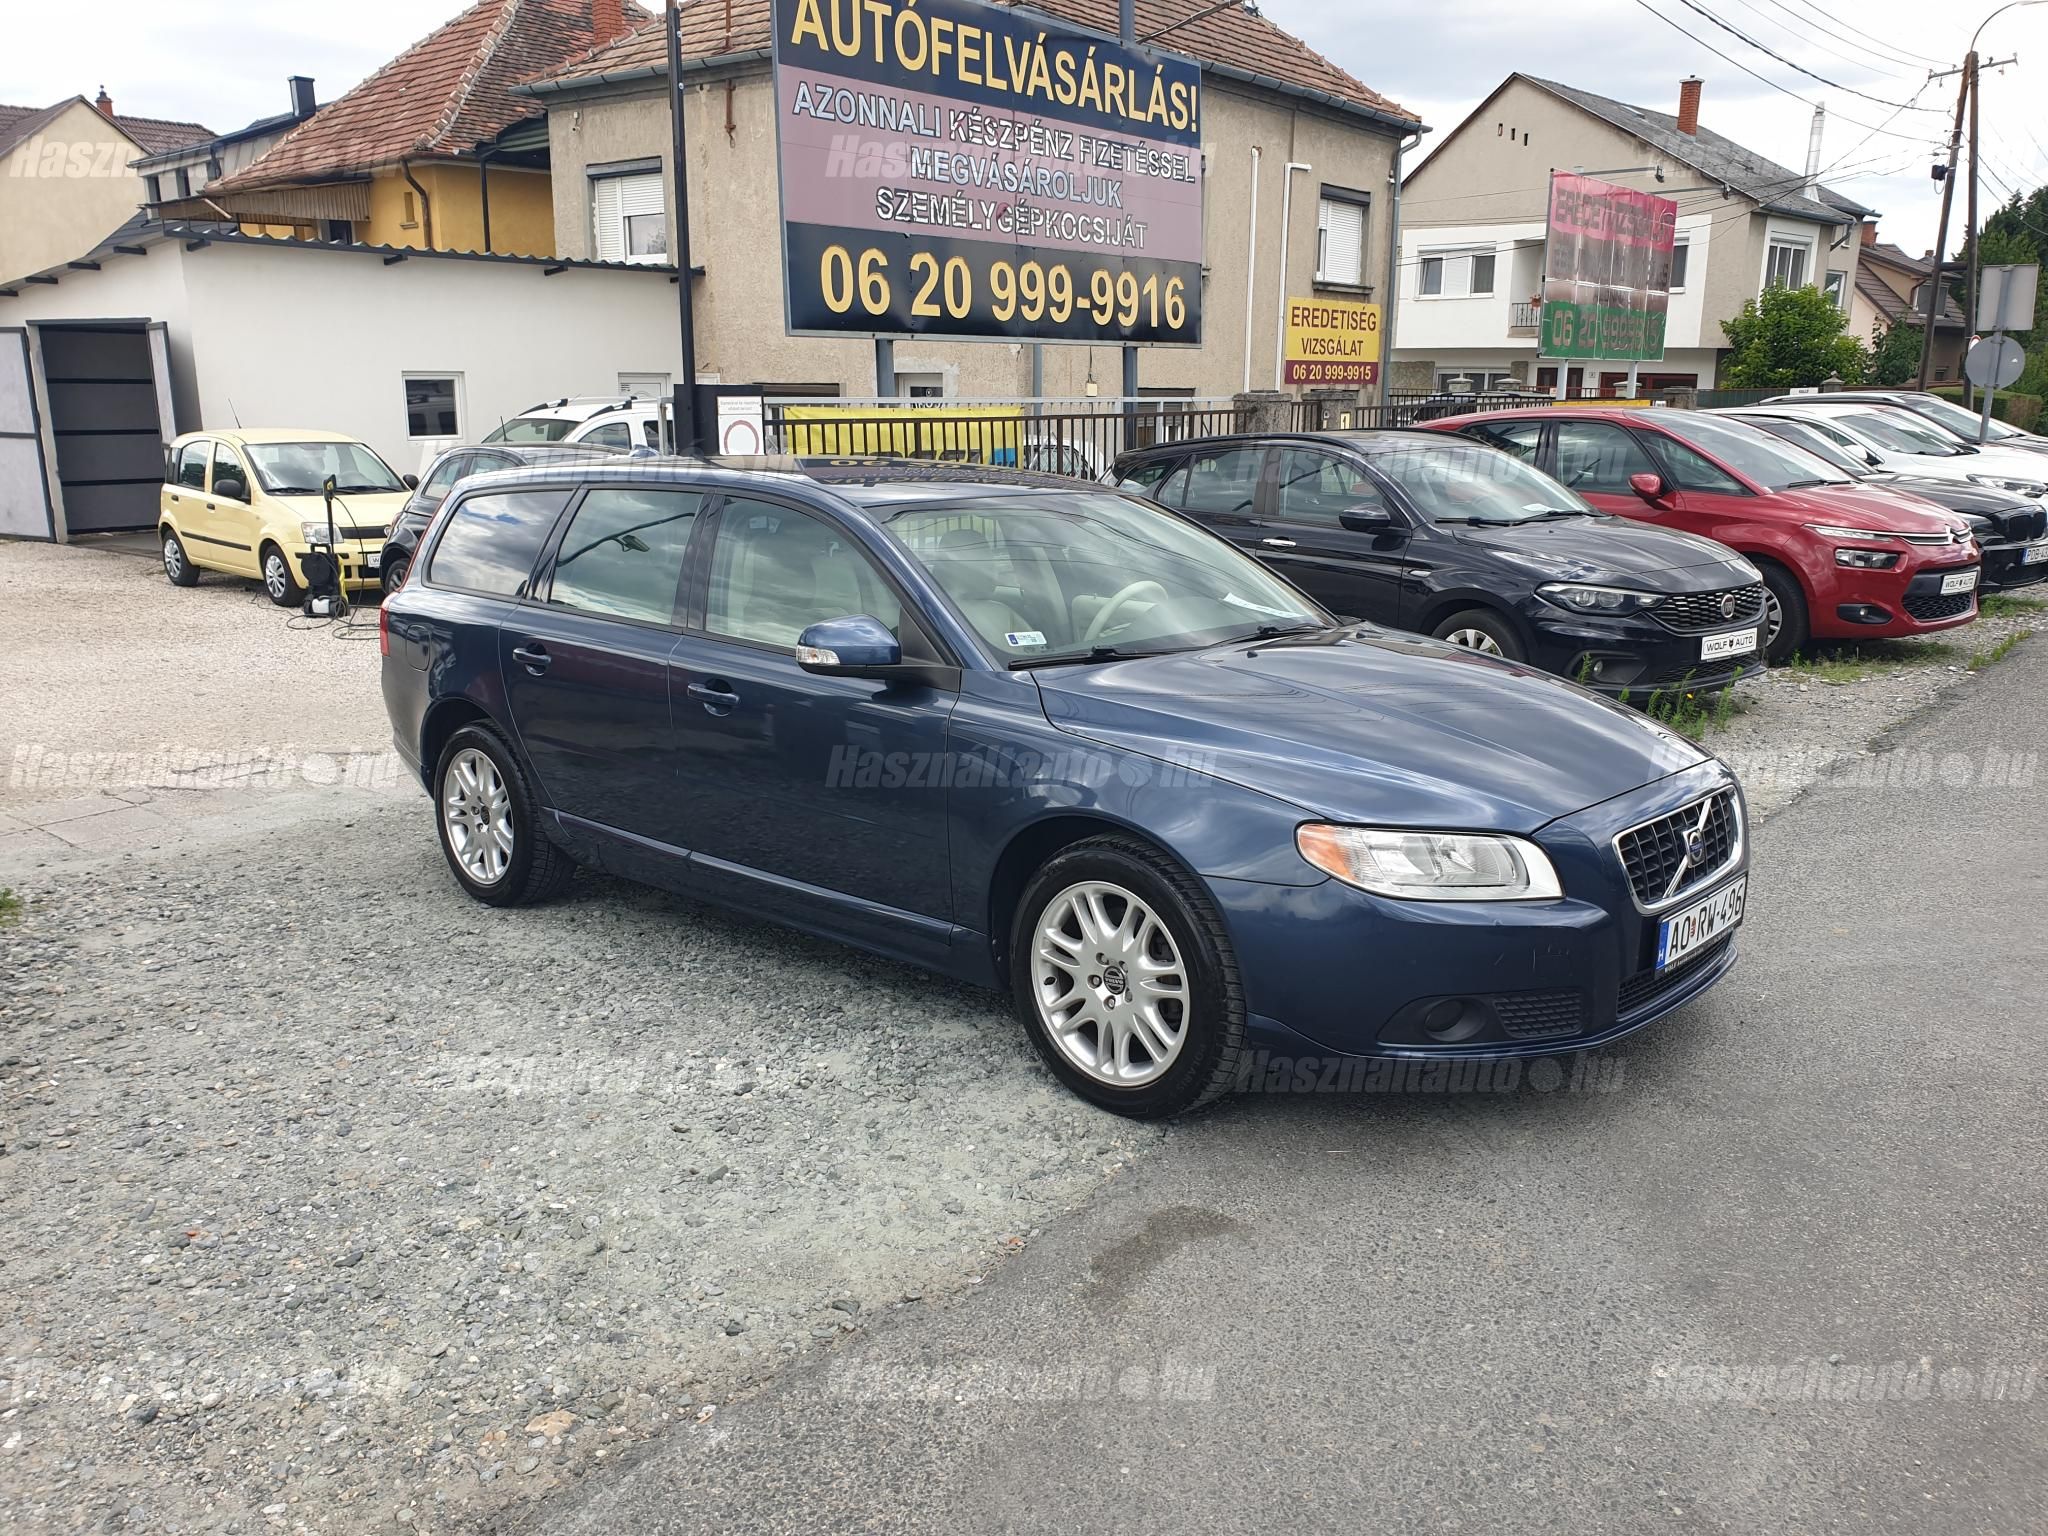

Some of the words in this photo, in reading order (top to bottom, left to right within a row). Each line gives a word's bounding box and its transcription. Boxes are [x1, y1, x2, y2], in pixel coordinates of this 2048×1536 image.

[791, 0, 1198, 132] AUTÓFELVÁSÁRLÁS!
[792, 81, 941, 140] AZONNALI
[949, 107, 1074, 161] KÉSZPÉNZ
[1079, 134, 1196, 184] FIZETÉSSEL
[910, 146, 1122, 208] MEGVÁSÁROLJUK
[820, 244, 891, 317] 06
[910, 250, 972, 319] 20
[989, 260, 1186, 330] 999-9916
[1291, 306, 1377, 332] EREDETISÉG
[1301, 336, 1364, 356] VIZSGÁLAT
[1292, 364, 1307, 380] 06
[1309, 365, 1322, 380] 20
[1325, 365, 1371, 380] 999-9915
[1706, 641, 1728, 651] WOLF
[1735, 636, 1753, 646] AUTO
[1669, 914, 1691, 957] AO
[1657, 949, 1665, 962] H
